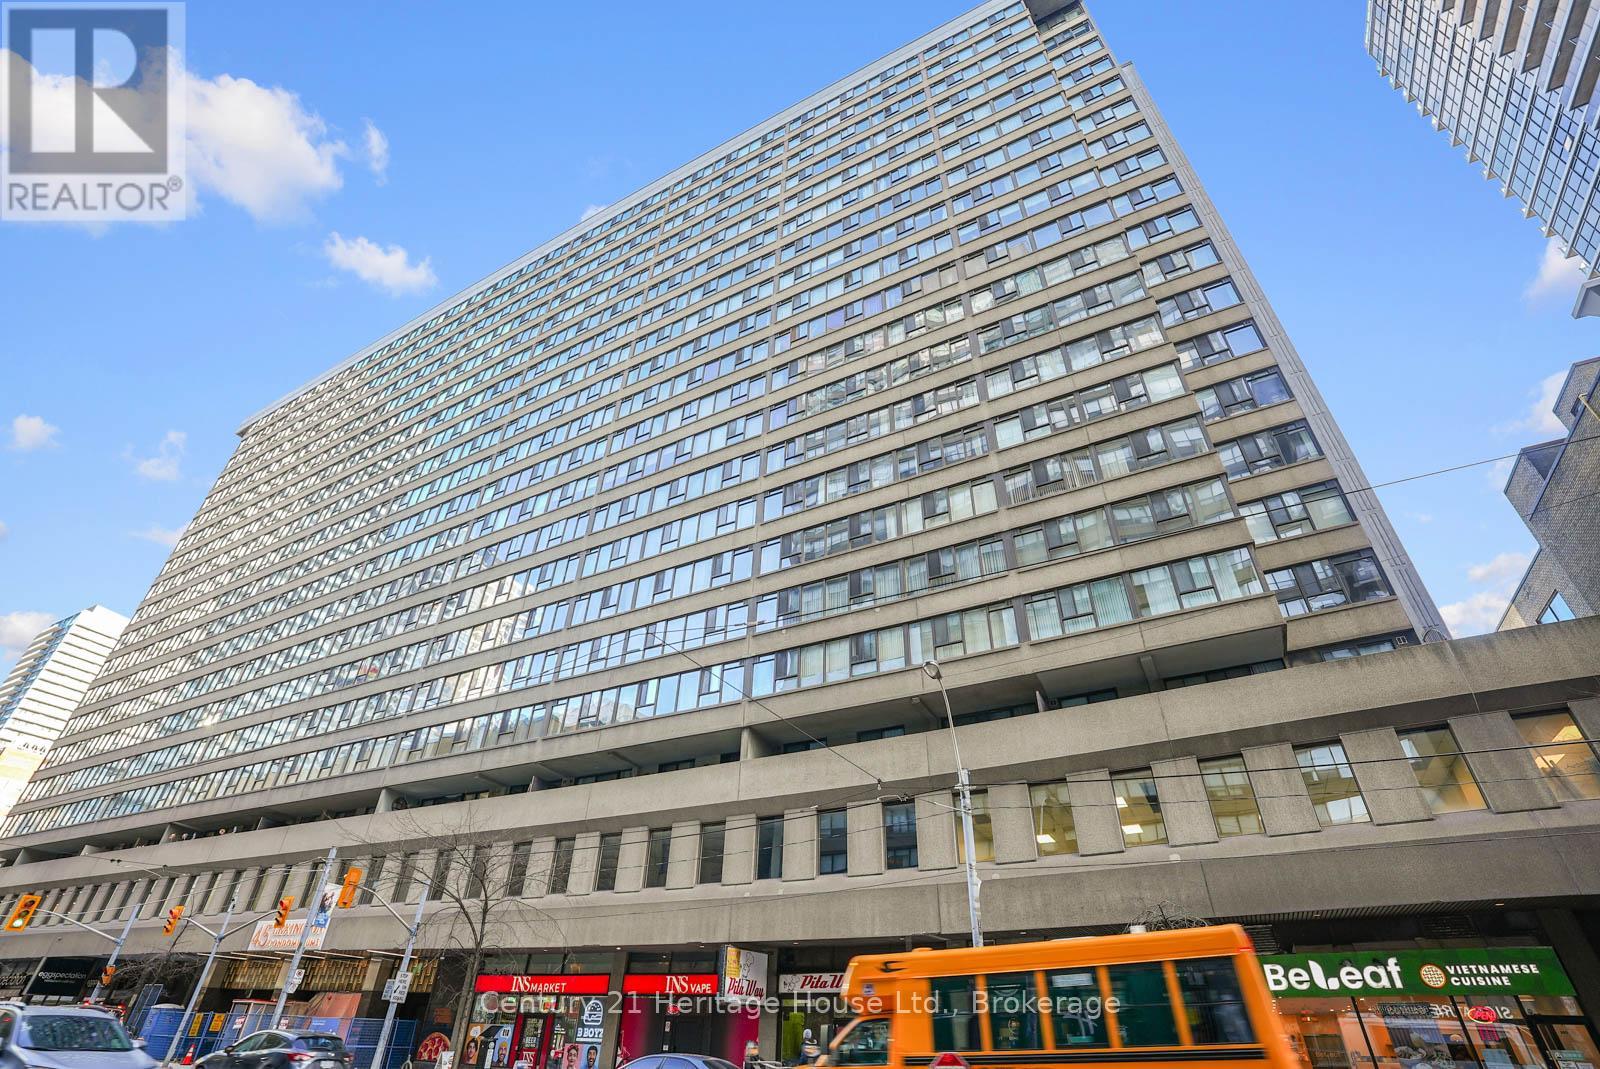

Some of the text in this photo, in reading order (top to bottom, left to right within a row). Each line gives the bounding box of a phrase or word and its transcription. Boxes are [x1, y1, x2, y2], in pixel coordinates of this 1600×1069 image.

[38, 971, 87, 980] eggspectation
[1446, 963, 1540, 976] VIETNAMESE
[510, 976, 567, 993] INS MARKET
[665, 975, 712, 993] INS VAPE
[800, 975, 829, 989] Pita
[1450, 976, 1511, 987] CUISINE
[727, 977, 765, 1001] Pita Way
